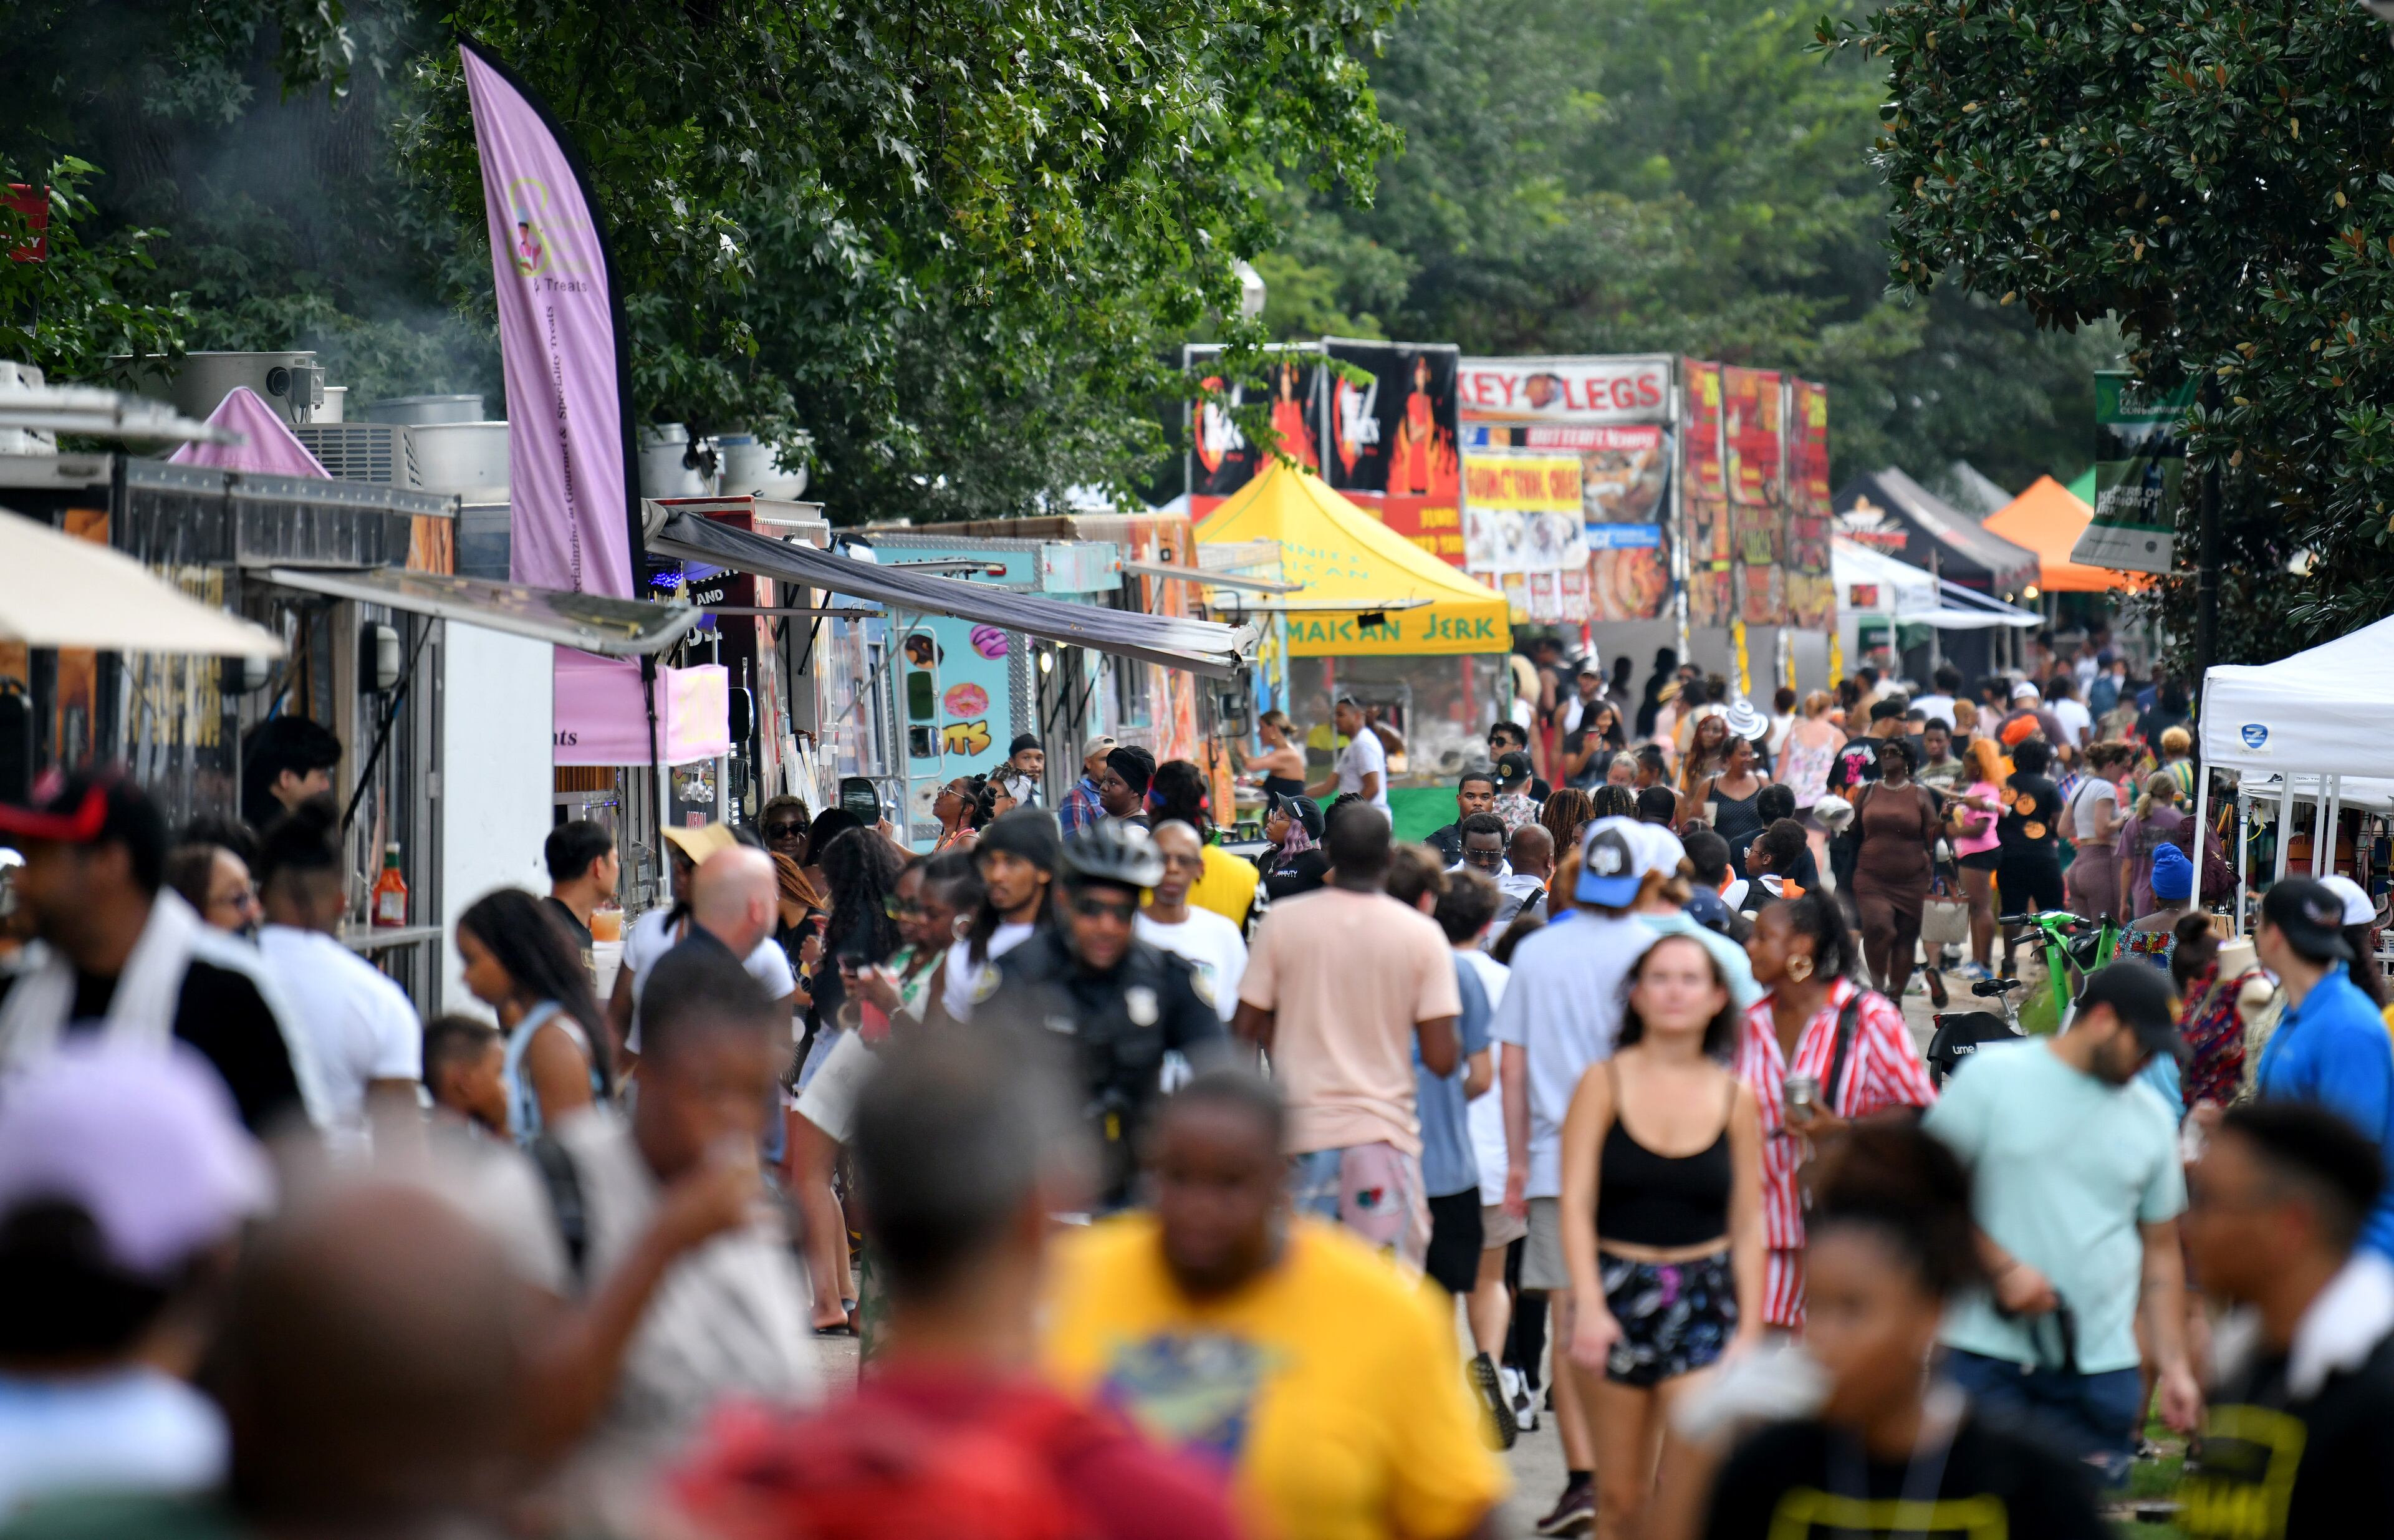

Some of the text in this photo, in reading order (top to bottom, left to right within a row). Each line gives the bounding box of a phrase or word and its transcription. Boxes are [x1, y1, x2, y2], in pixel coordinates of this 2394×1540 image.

[544, 277, 588, 293] Treats
[546, 306, 559, 349] Treats
[551, 354, 568, 421] Speciality
[1562, 373, 1663, 410] LEGS
[559, 428, 568, 440] &
[560, 442, 574, 504] Gourmet
[569, 524, 583, 594] ecialinzin
[696, 588, 724, 607] AND
[1422, 613, 1495, 641] JERK
[686, 811, 708, 829] MENU
[1952, 1045, 1975, 1055] Lime
